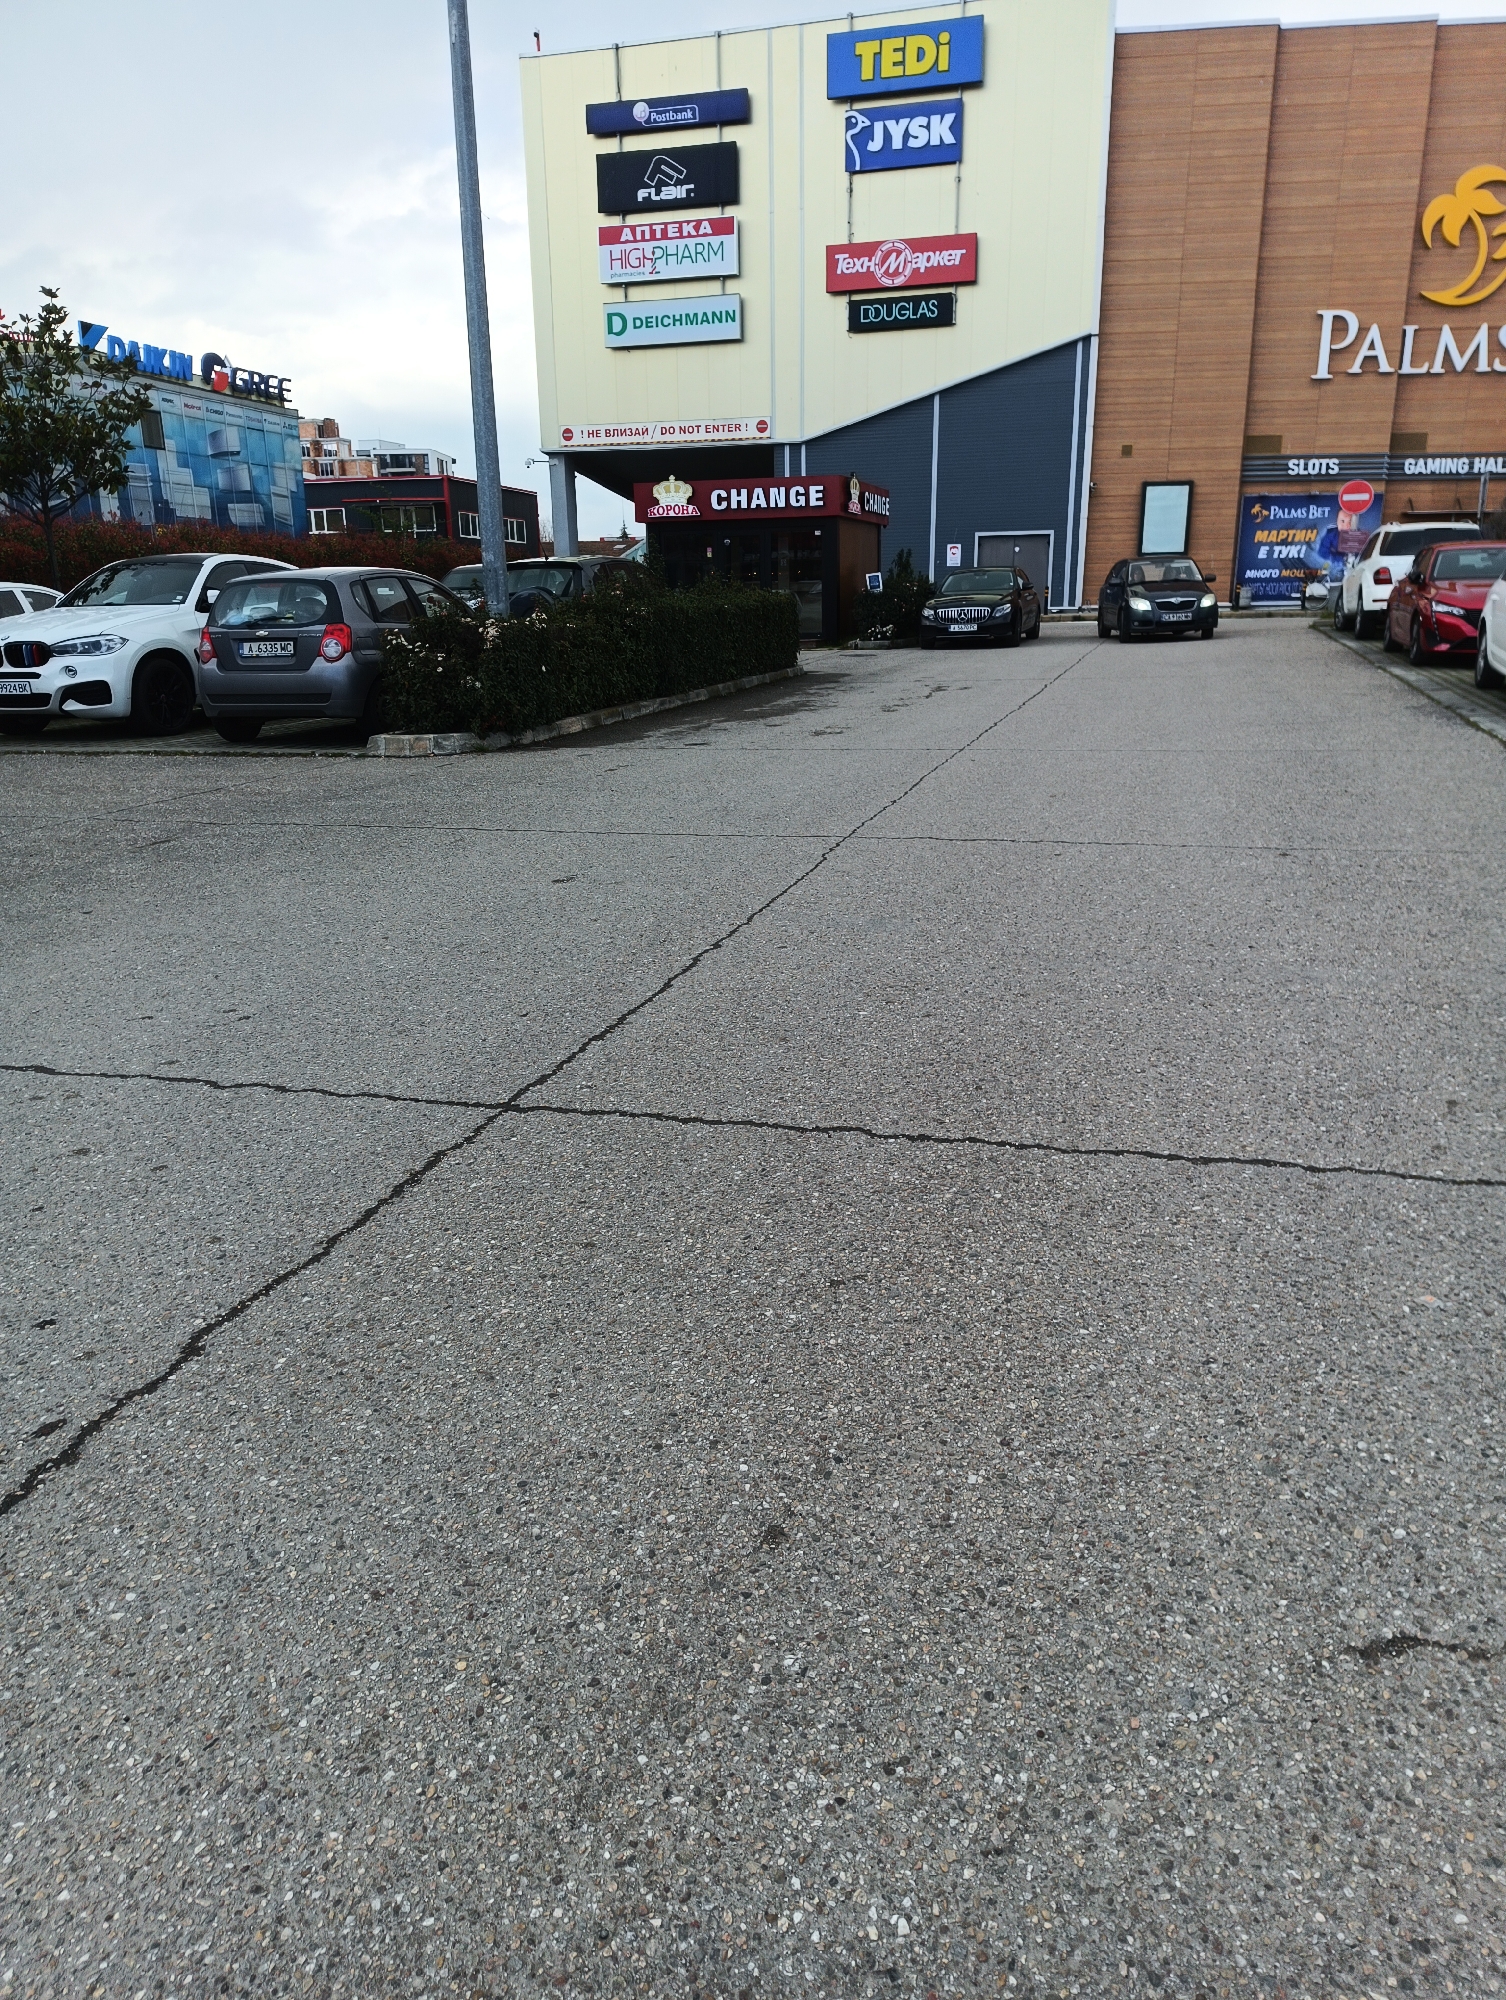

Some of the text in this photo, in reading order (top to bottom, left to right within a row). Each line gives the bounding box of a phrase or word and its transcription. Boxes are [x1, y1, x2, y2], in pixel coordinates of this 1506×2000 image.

[855, 31, 951, 81] TEDi
[650, 109, 693, 122] Postbank
[866, 113, 957, 152] JYSK
[619, 221, 713, 242] АПТЕКА
[610, 270, 646, 279] pharmacies
[632, 309, 737, 330] DEICHMANN
[860, 300, 938, 323] DOUGLAS
[107, 334, 193, 381] DAIKIN
[230, 367, 293, 402] GREE
[587, 429, 602, 438] НЕ
[604, 425, 649, 438] ВЛИЗАЙ
[660, 426, 676, 436] DO
[679, 425, 702, 435] NOT
[705, 423, 742, 434] ENTER
[1287, 458, 1340, 475] SLOTS
[1404, 457, 1470, 474] GAMING
[711, 485, 824, 510] CHANGE
[864, 491, 890, 516] CHANGE
[648, 503, 699, 517] КОРОНА
[1270, 504, 1331, 520] PALMS BET
[1254, 529, 1318, 543] МАРТИН
[1257, 545, 1270, 559] Е
[1244, 568, 1280, 578] МНОГО
[257, 643, 279, 653] 6335
[280, 642, 293, 653] MC
[18, 683, 28, 693] BK
